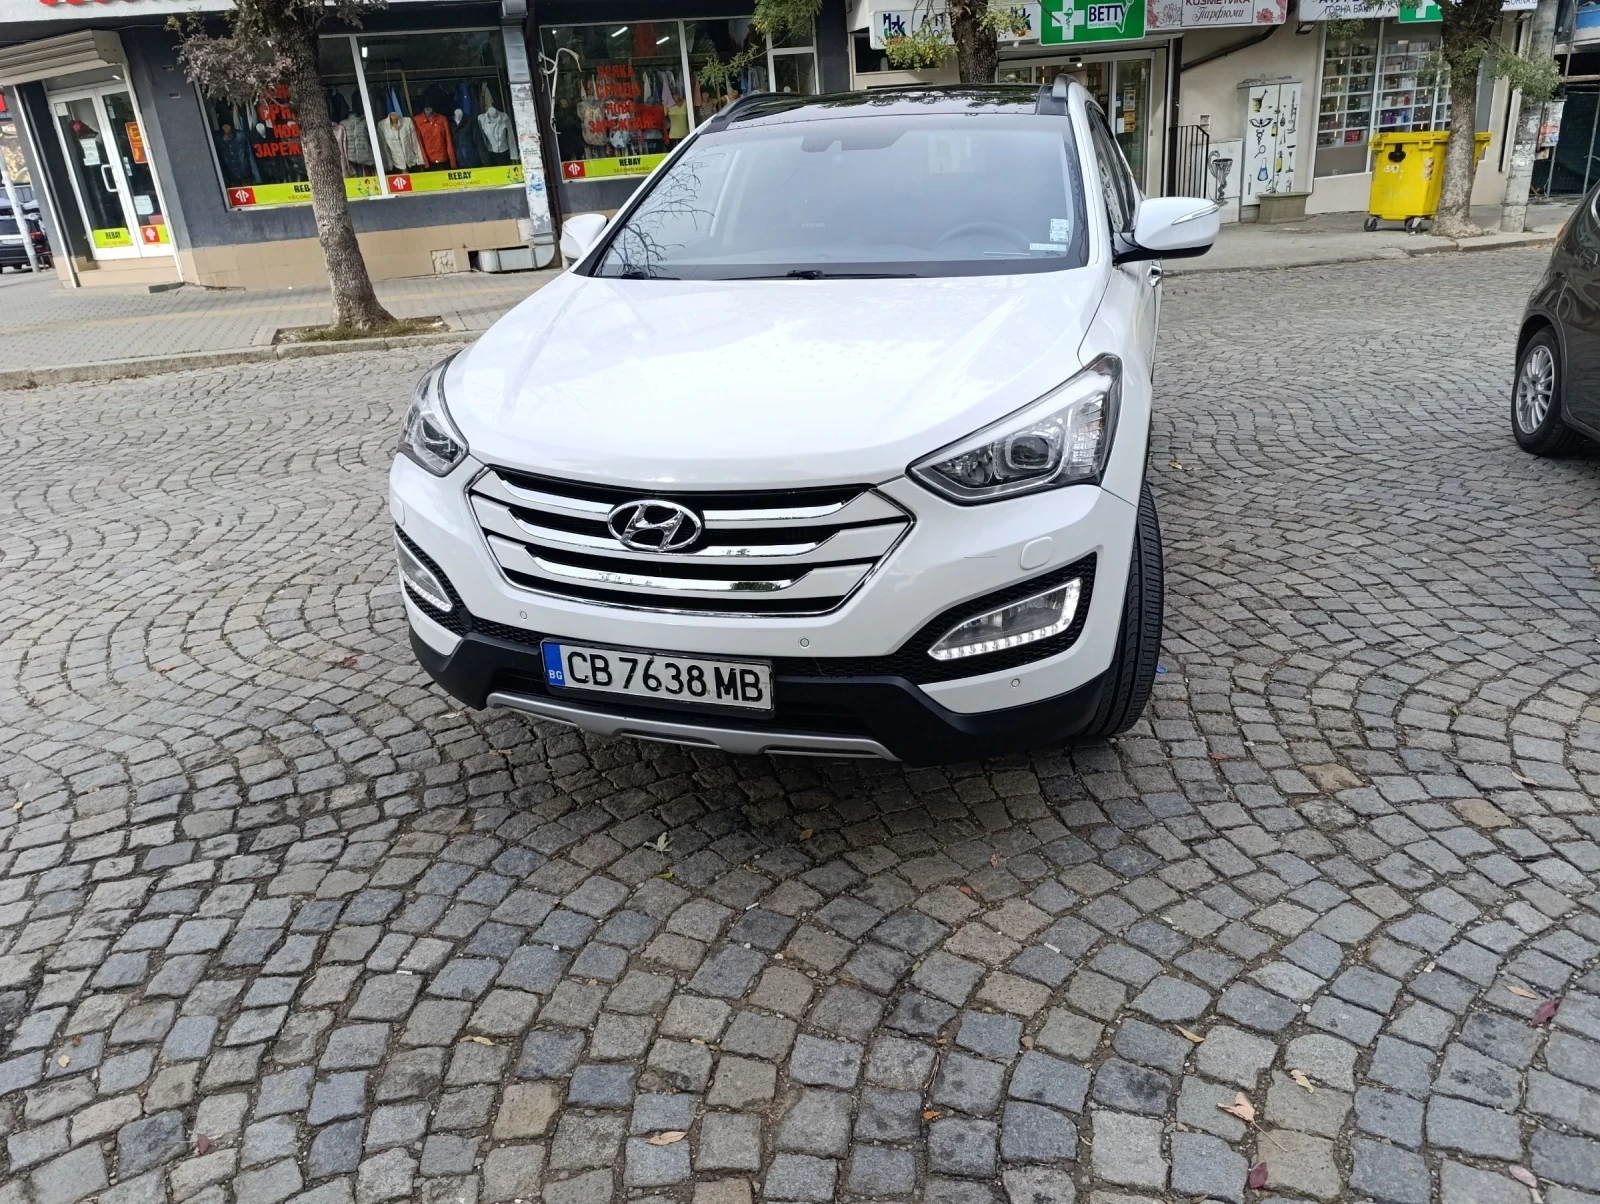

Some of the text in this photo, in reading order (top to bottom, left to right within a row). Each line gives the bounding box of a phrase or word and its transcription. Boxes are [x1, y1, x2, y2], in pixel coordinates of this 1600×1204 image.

[1088, 4, 1128, 26] BETTY
[1192, 6, 1245, 22] Парфюми
[272, 124, 301, 139] НОВ
[253, 141, 304, 158] ЗАРЕЖ
[618, 157, 641, 167] REBAY
[447, 171, 472, 181] REBAY
[293, 184, 311, 193] REB
[105, 231, 122, 240] REBAY
[548, 669, 563, 680] BG
